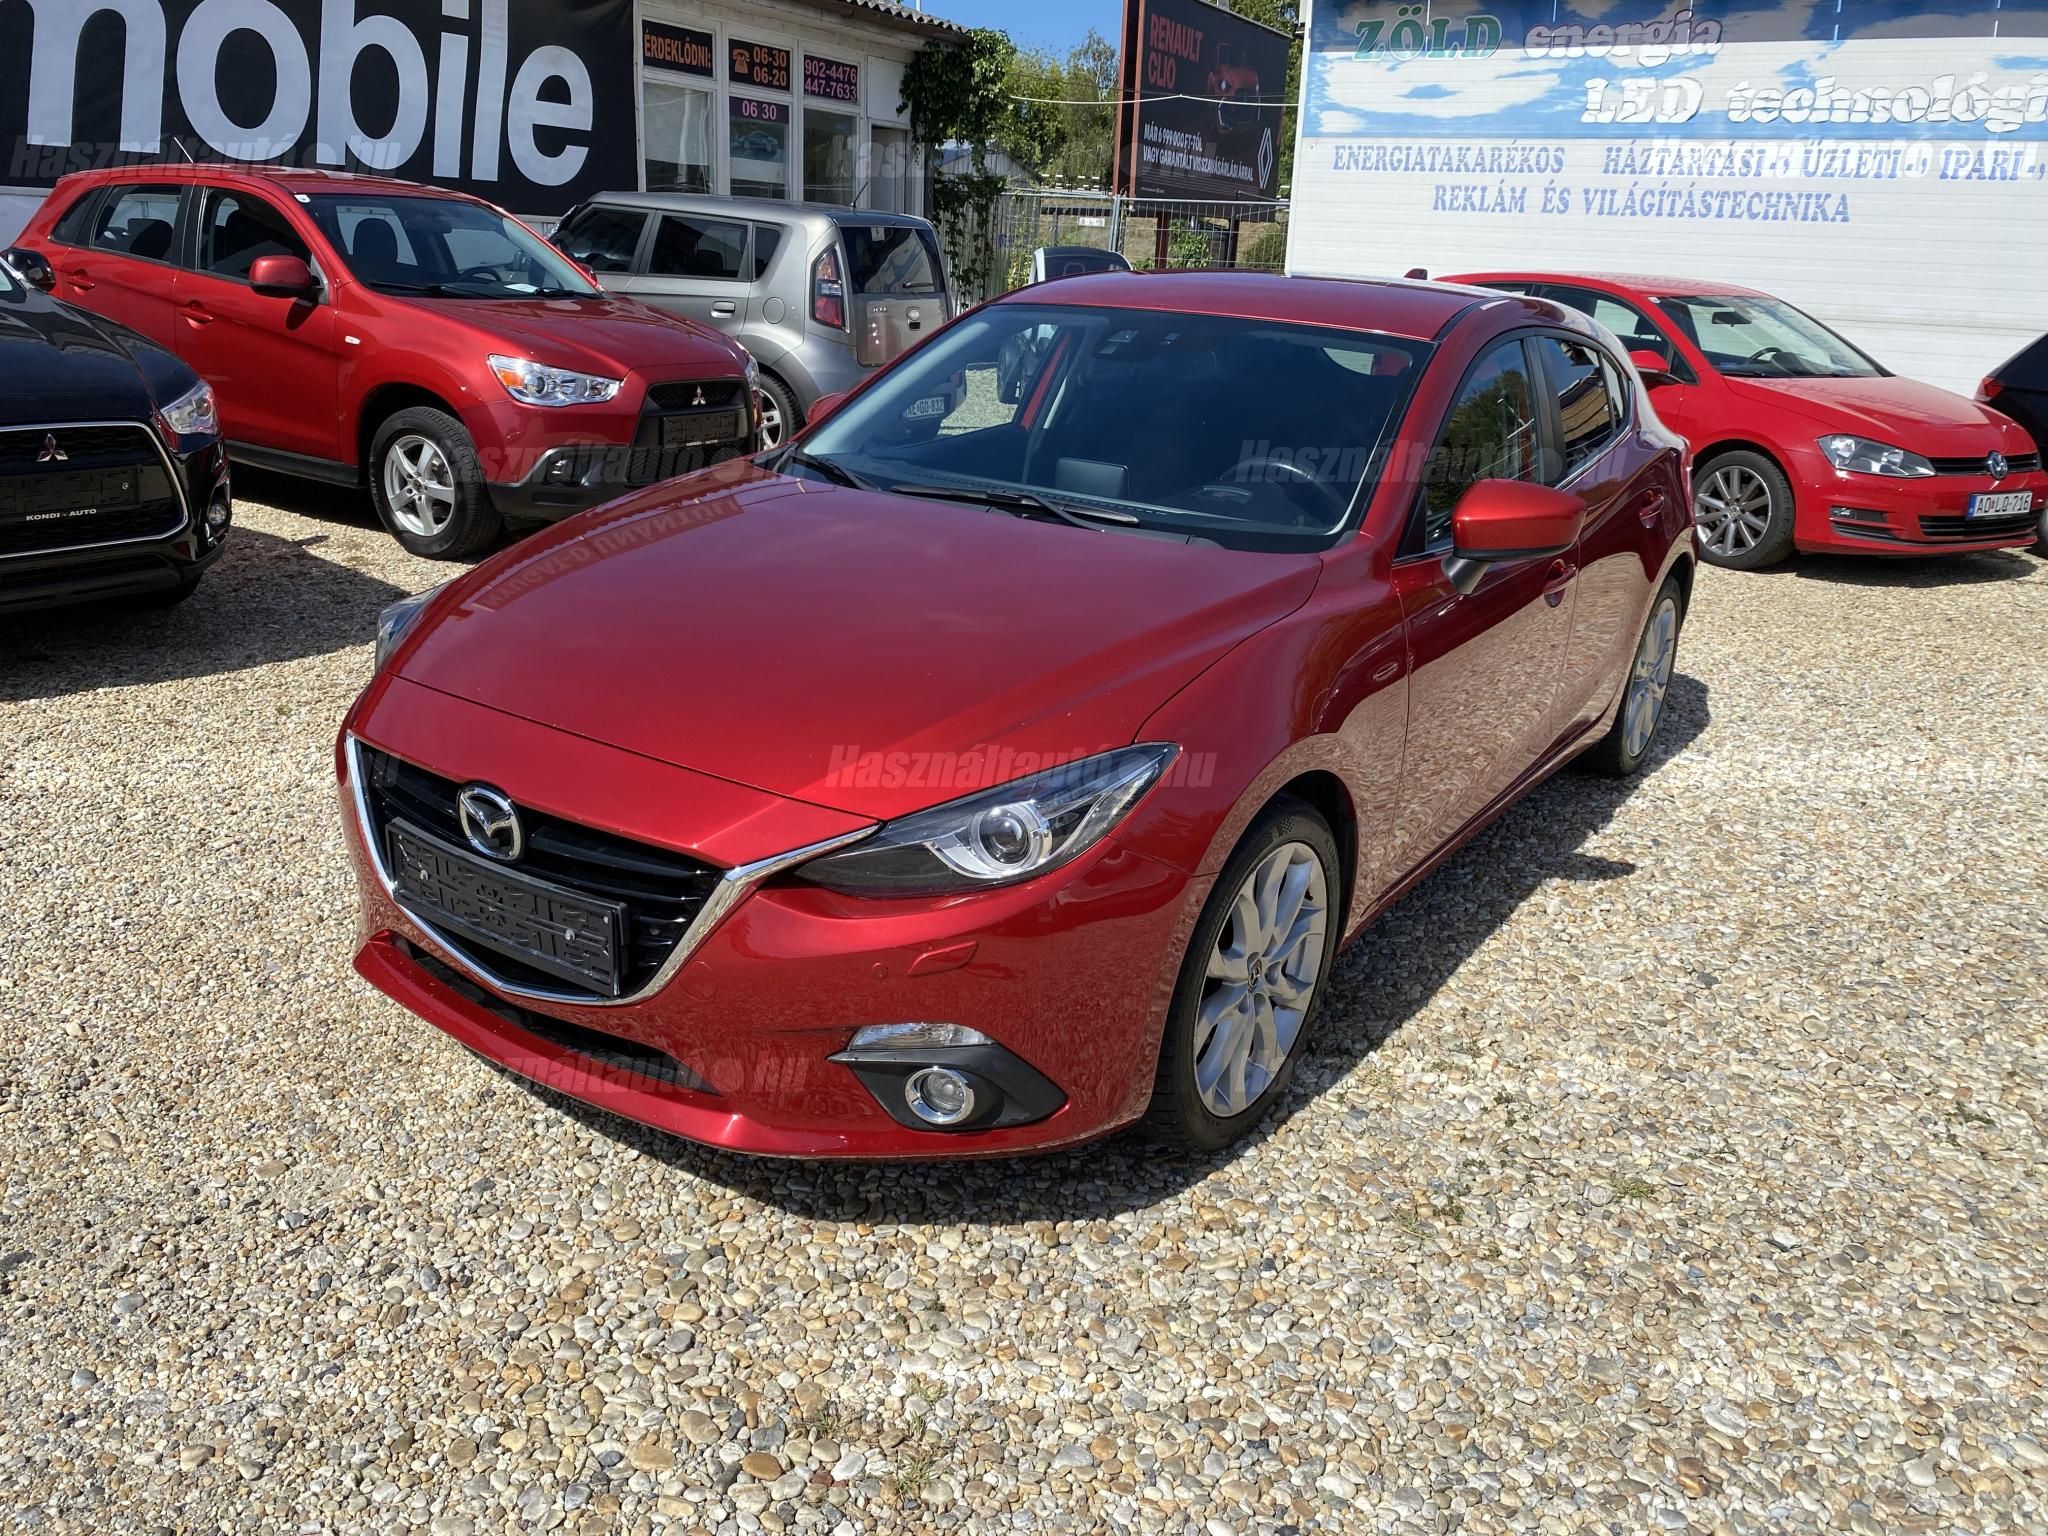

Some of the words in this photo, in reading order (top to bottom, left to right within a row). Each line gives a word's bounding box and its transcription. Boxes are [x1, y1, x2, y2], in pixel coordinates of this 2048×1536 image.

[644, 28, 711, 69] ÉRDEKLŐDNI:
[1150, 15, 1204, 62] RENAULT
[1352, 6, 1502, 62] ZÖLD
[1524, 9, 1724, 68] energia
[753, 46, 787, 68] 06-30
[753, 66, 787, 87] 06-20
[805, 59, 857, 83] 902-4476
[1148, 52, 1177, 90] CLIO
[805, 77, 857, 100] 447-7633
[1580, 76, 1704, 124] LED
[742, 100, 758, 118] 06
[762, 104, 777, 121] 30
[1144, 121, 1158, 141] MÁR
[1173, 130, 1185, 148] 000
[1143, 145, 1160, 163] VAGY
[1160, 148, 1193, 170] GARANTÁLT
[1332, 139, 1566, 174] ENERGIATAKARÉKOS
[1432, 179, 1528, 213] REKLÁM
[1540, 179, 1572, 214] ÉS
[1583, 180, 1850, 222] VILÁGÍTÁSTECHNIKA
[26, 512, 61, 521] KONDI
[69, 508, 97, 517] AUTO
